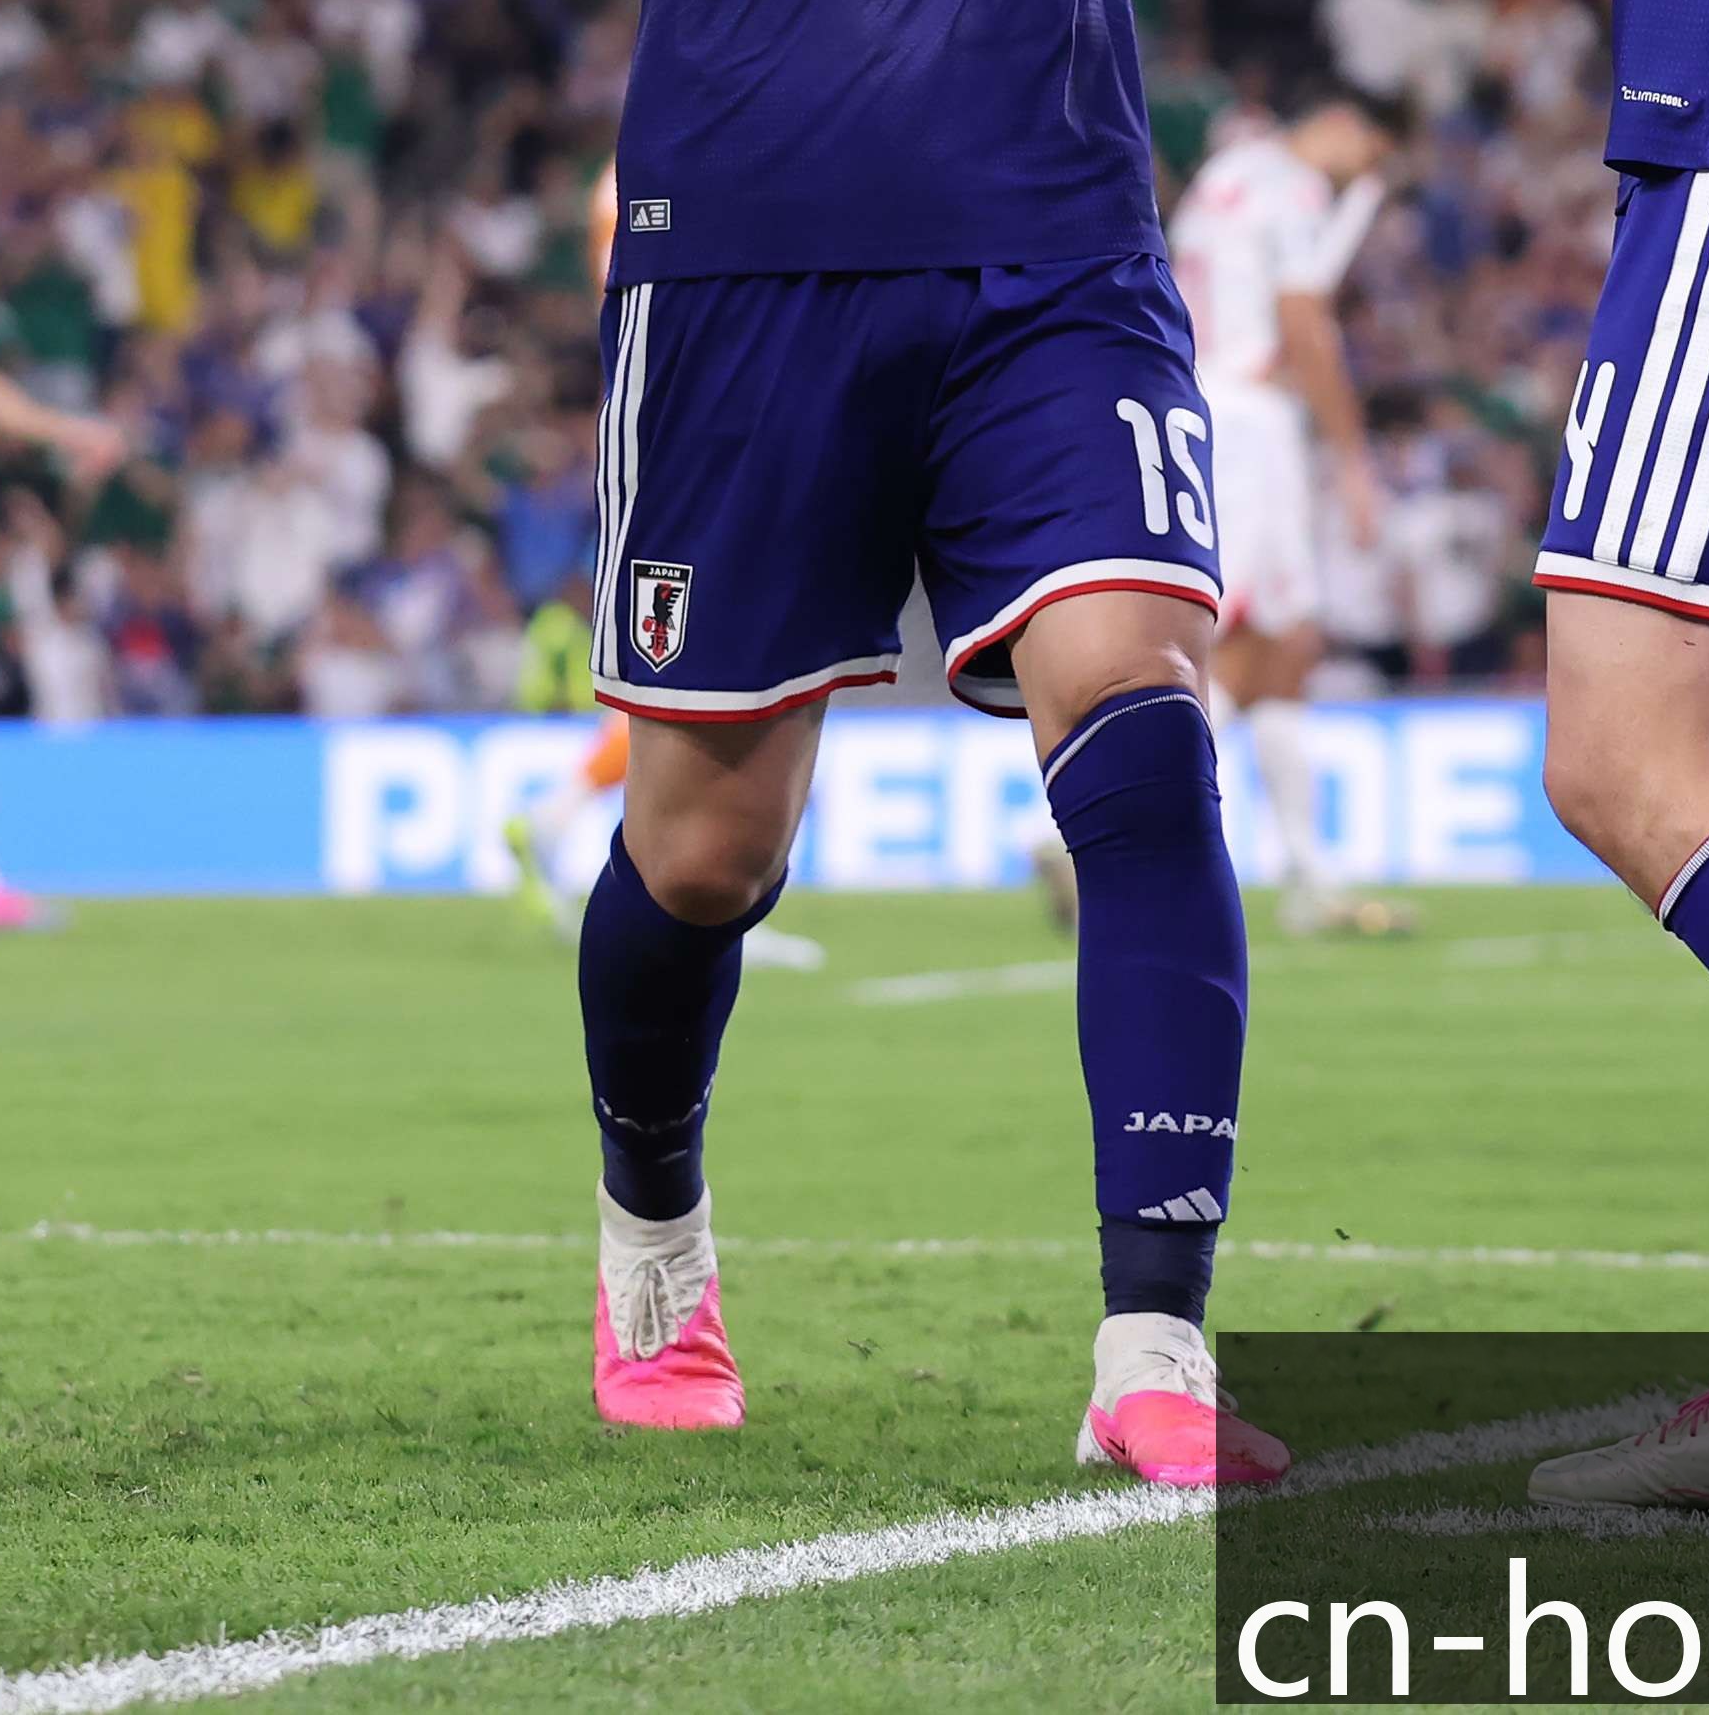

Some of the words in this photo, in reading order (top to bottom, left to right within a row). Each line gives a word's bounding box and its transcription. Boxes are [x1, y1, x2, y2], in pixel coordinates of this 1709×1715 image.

[1116, 397, 1215, 551] 15
[648, 567, 681, 579] JAPAN
[1123, 1111, 1239, 1141] JAPA
